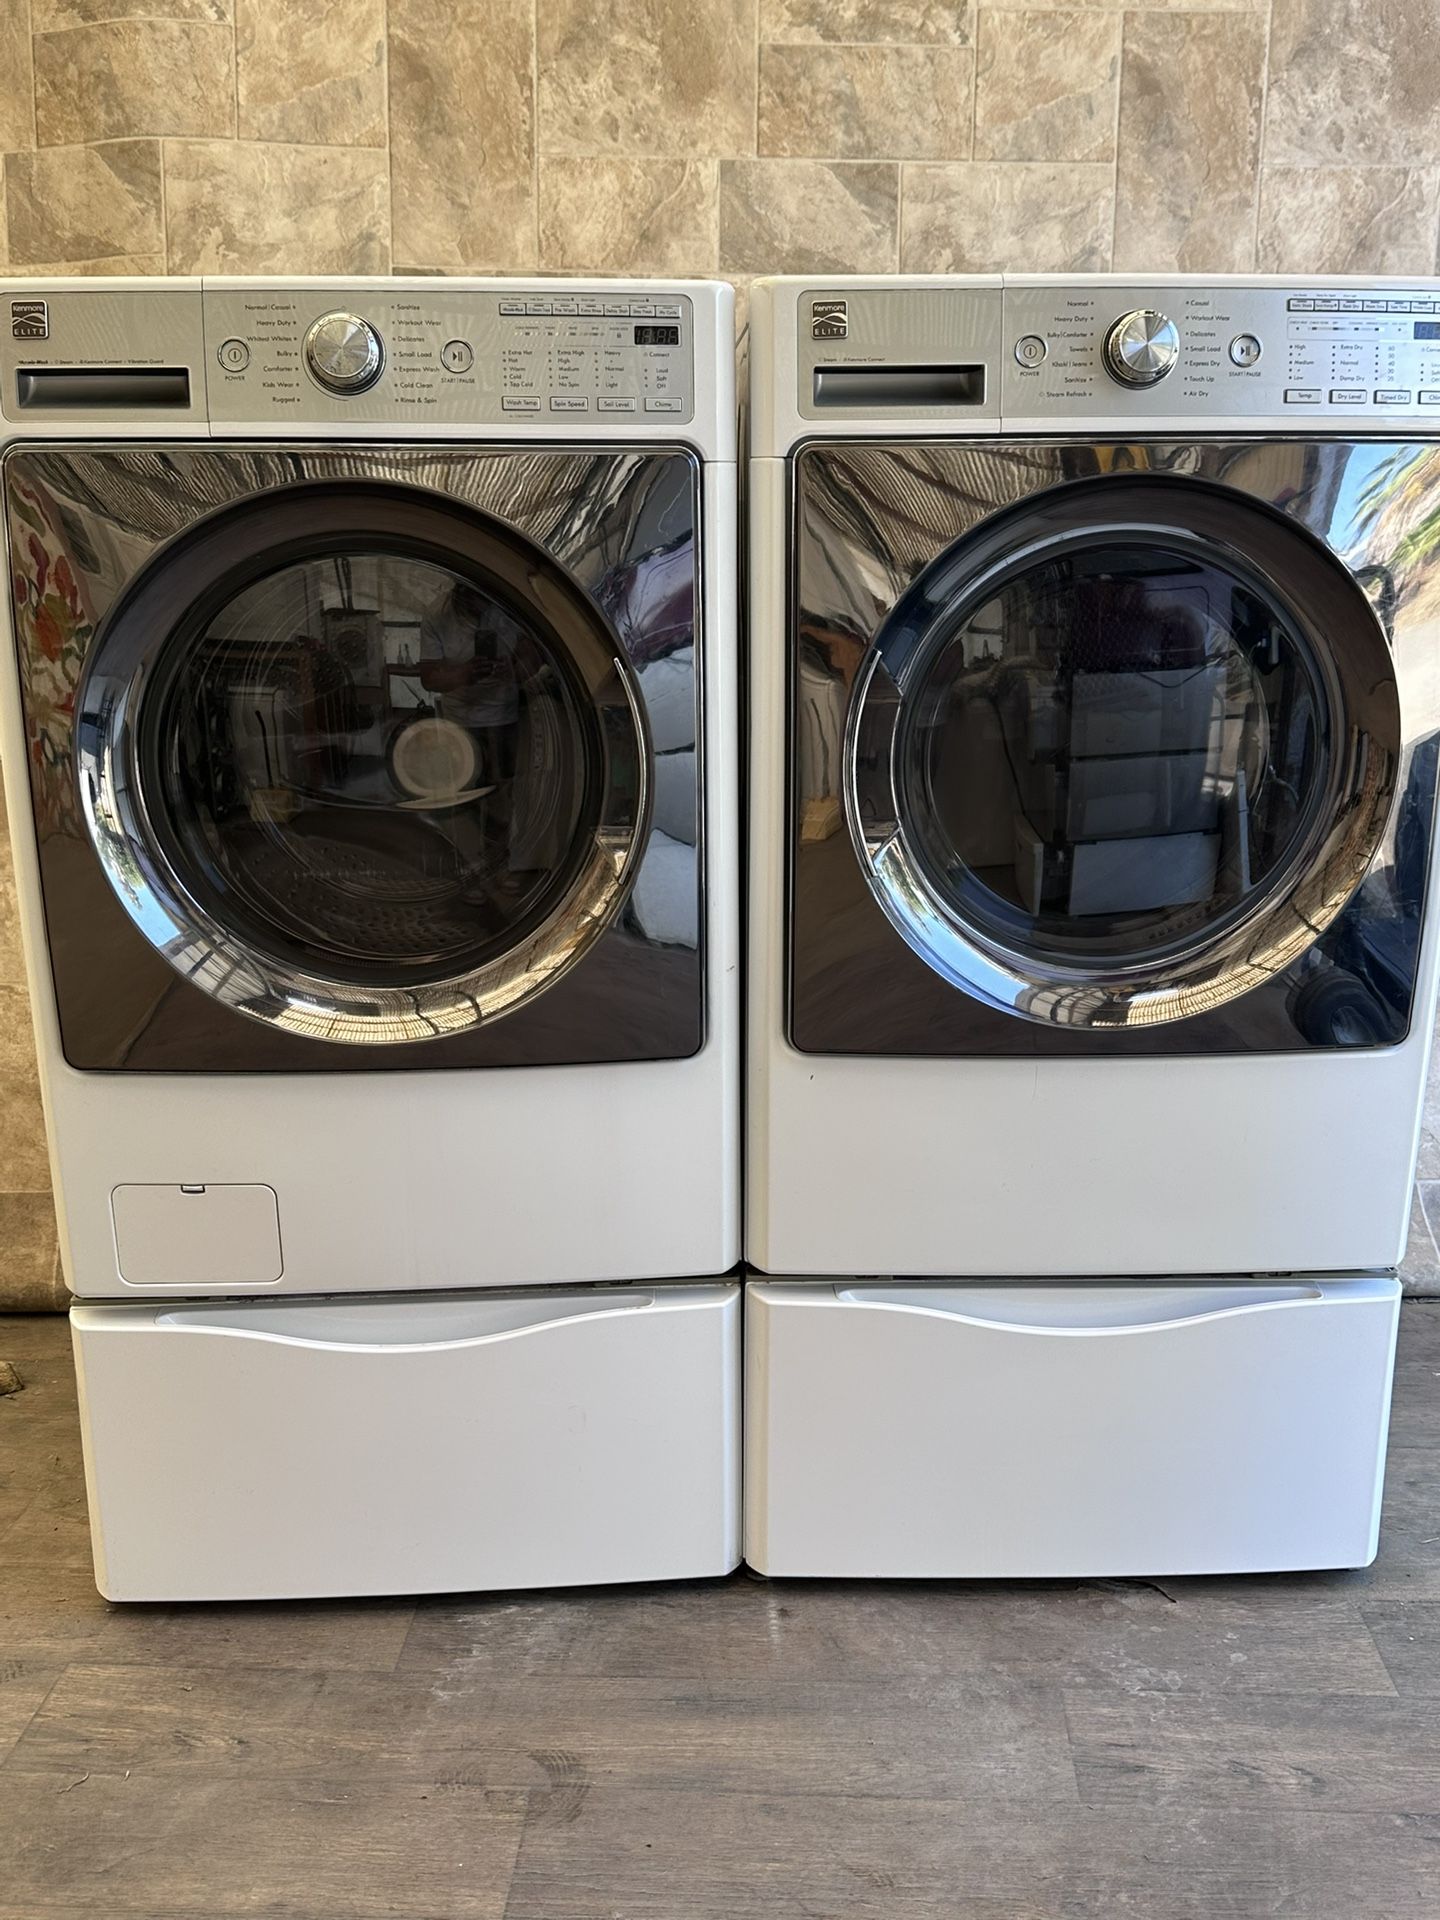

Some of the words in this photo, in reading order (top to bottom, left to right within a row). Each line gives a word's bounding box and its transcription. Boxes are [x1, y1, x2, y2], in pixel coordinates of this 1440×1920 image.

[813, 304, 845, 312] Kenmore
[814, 328, 845, 336] ELITE
[272, 396, 296, 404] Rugged
